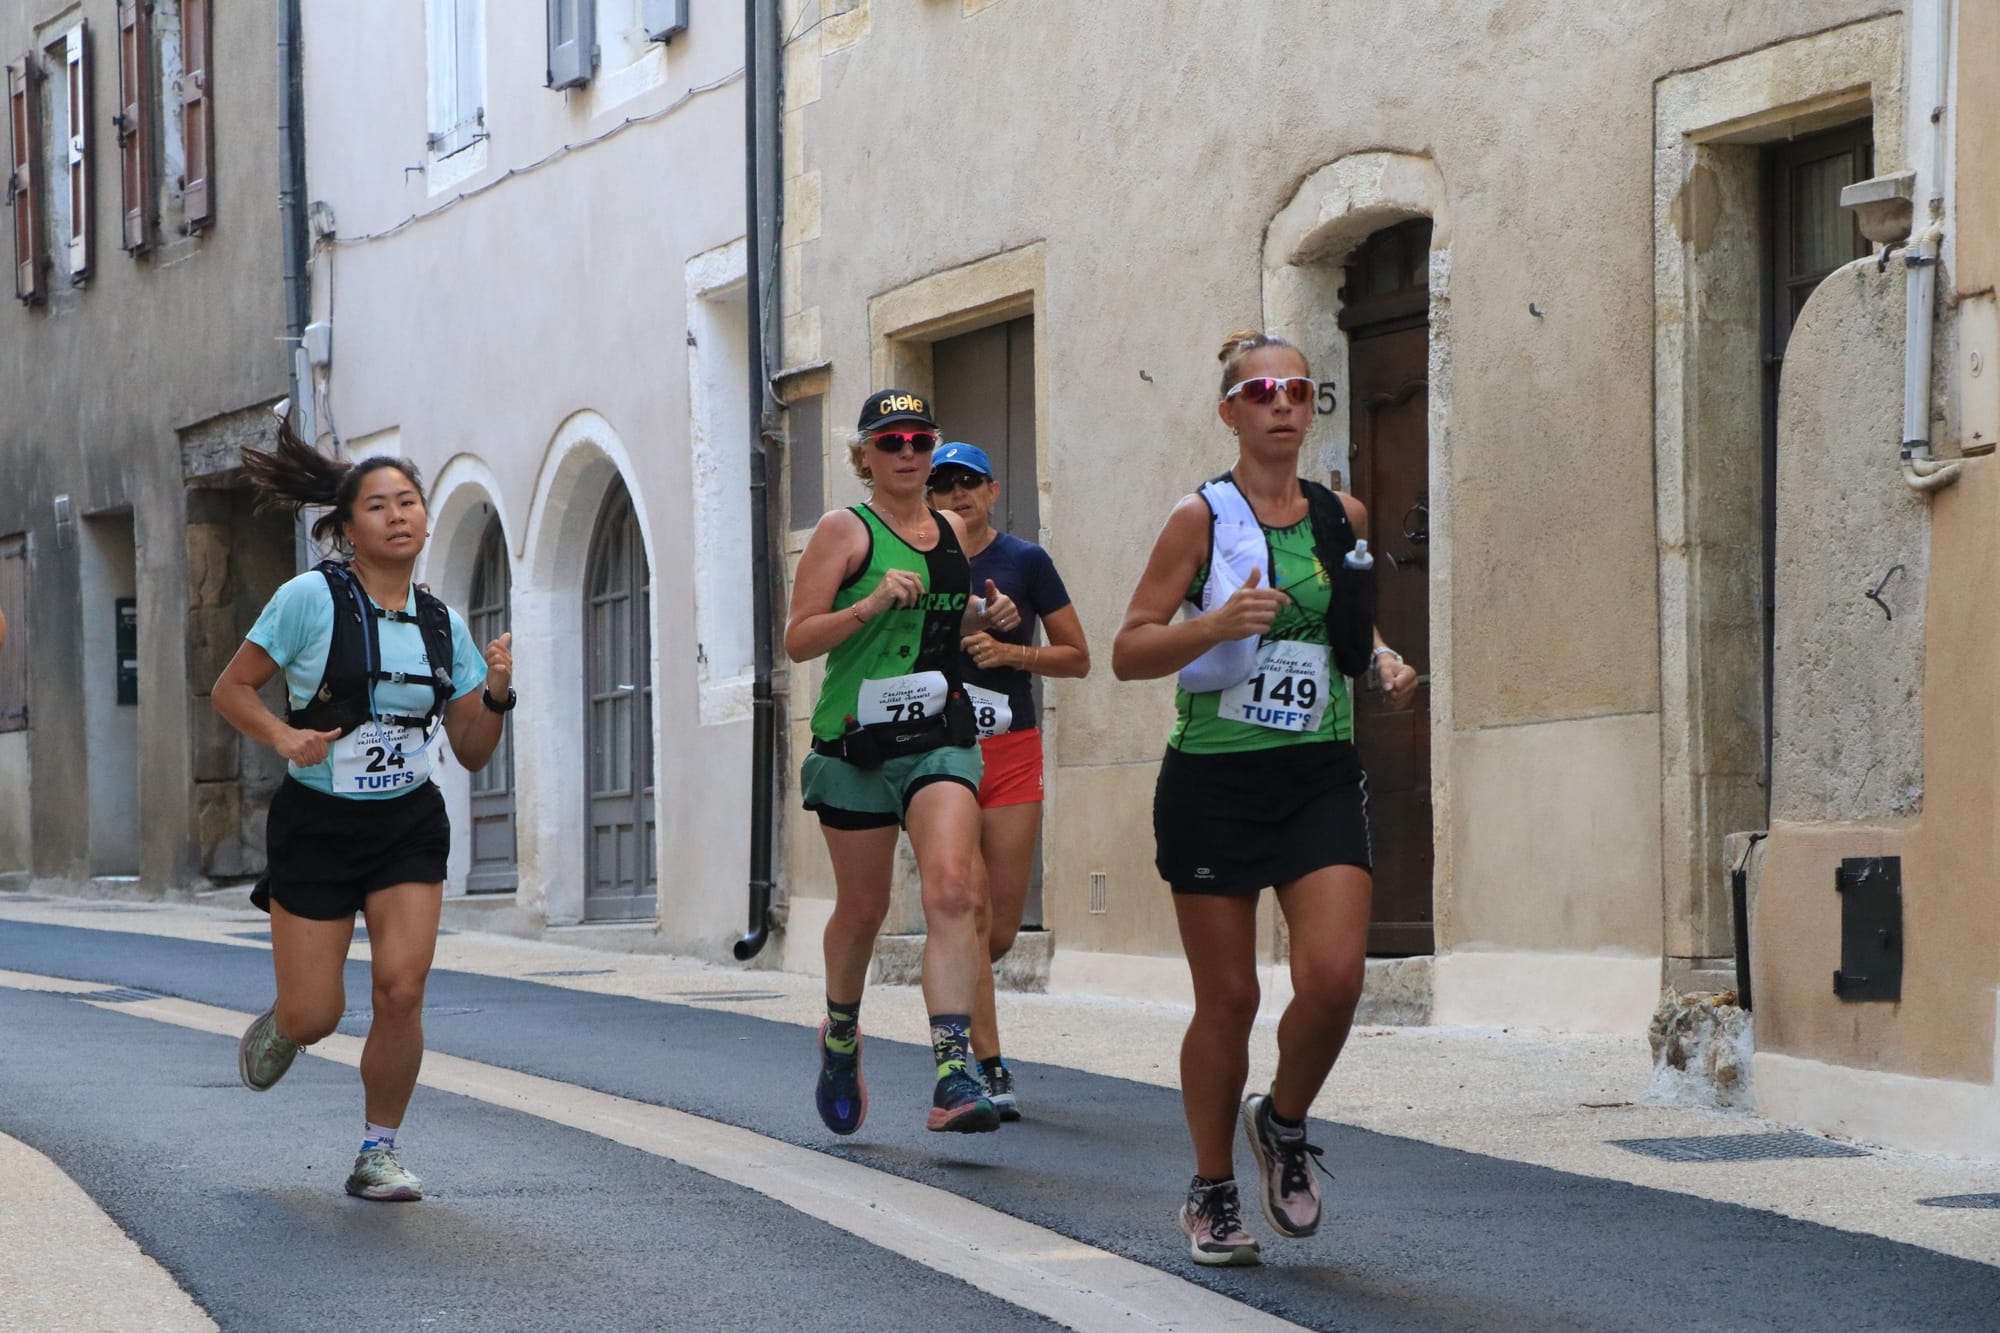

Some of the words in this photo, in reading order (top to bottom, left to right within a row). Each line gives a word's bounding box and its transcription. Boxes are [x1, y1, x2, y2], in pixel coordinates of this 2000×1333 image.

[880, 394, 923, 415] ciele
[1248, 673, 1317, 709] 149
[886, 702, 925, 722] 78
[1242, 704, 1312, 727] TUFF'S
[366, 743, 406, 773] 24
[355, 771, 414, 789] TUFF'S
